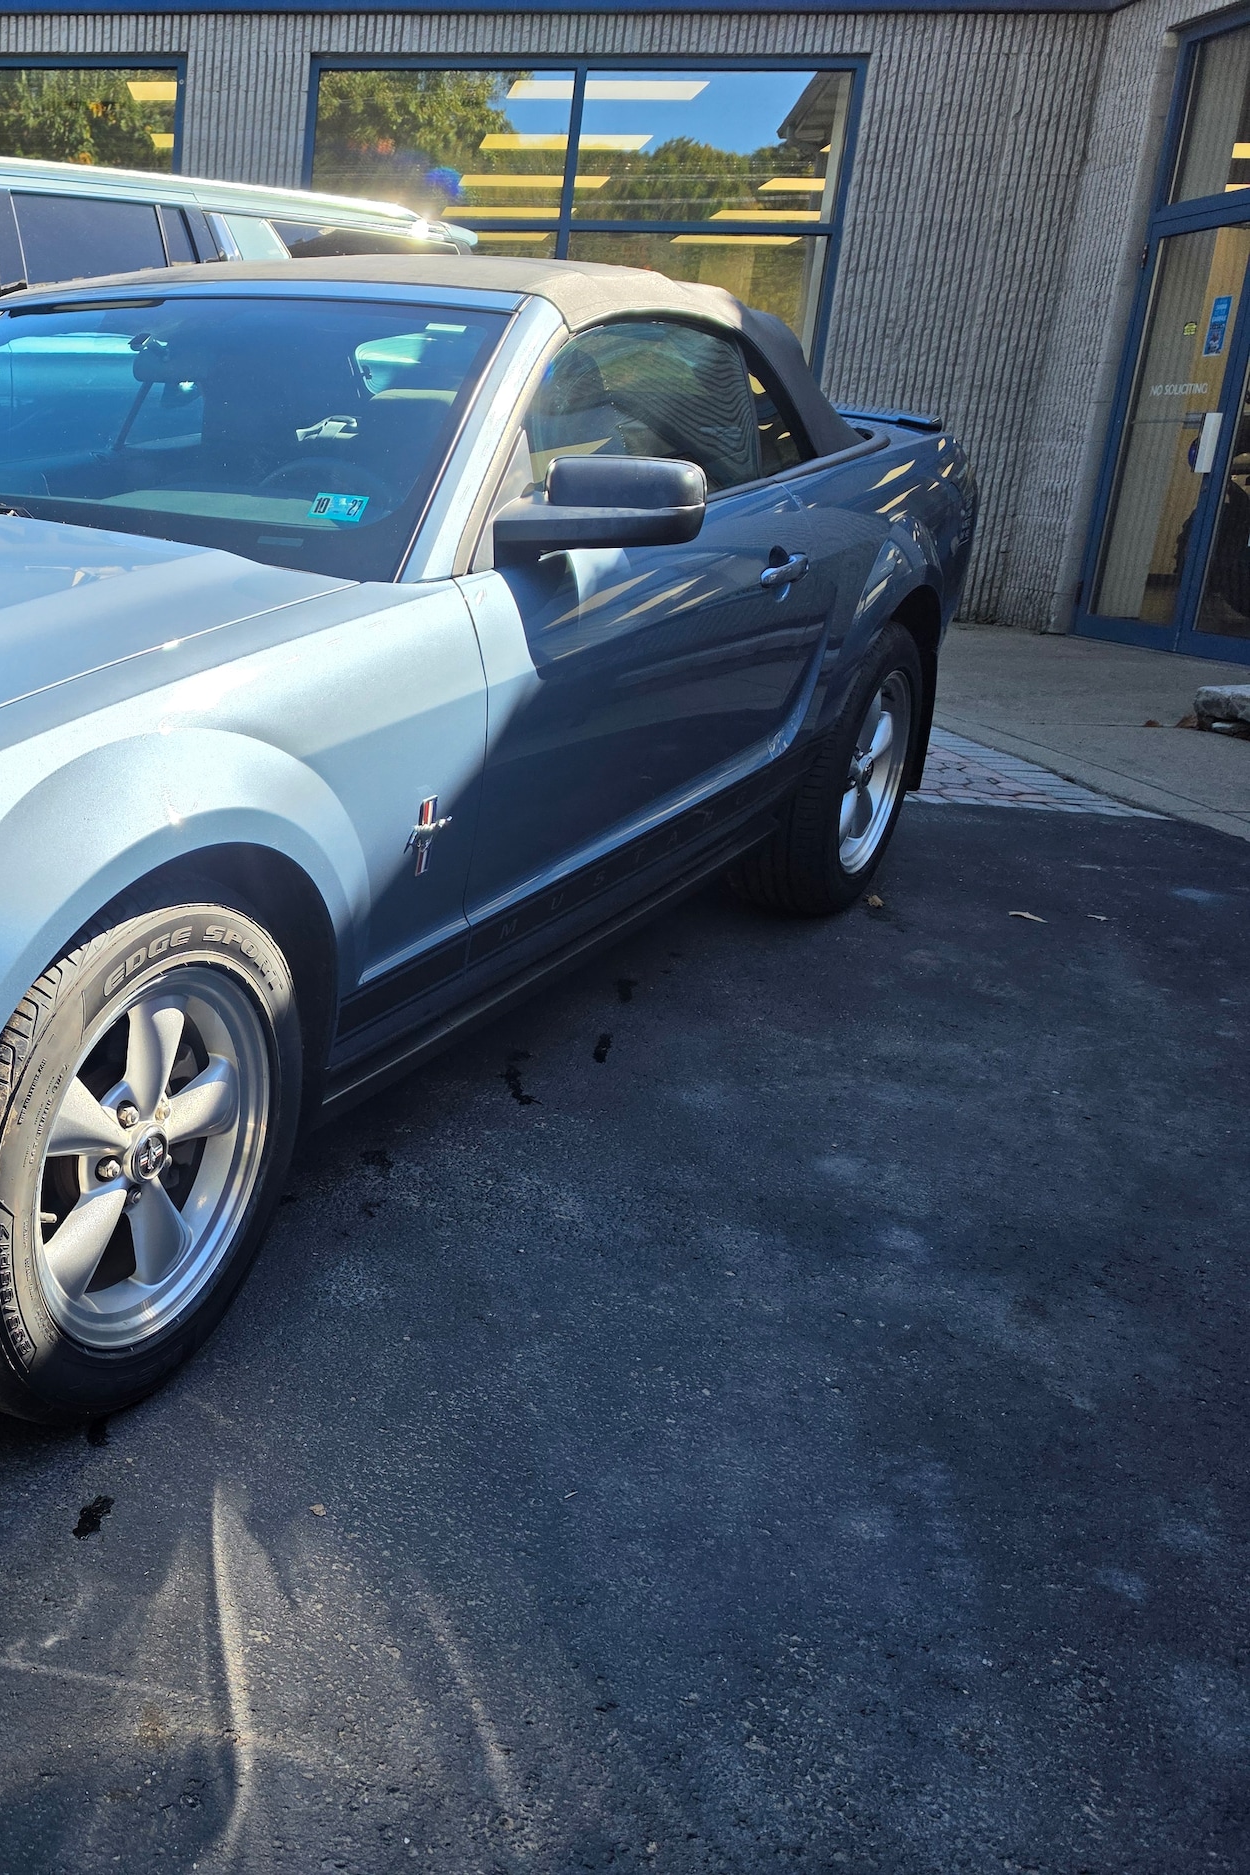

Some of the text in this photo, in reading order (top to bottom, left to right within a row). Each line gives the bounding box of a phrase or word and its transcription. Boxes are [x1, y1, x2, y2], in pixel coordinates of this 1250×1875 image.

[1150, 383, 1208, 396] NO SOLICITING
[313, 497, 364, 517] 10 27
[104, 925, 283, 996] EDGE SPORT
